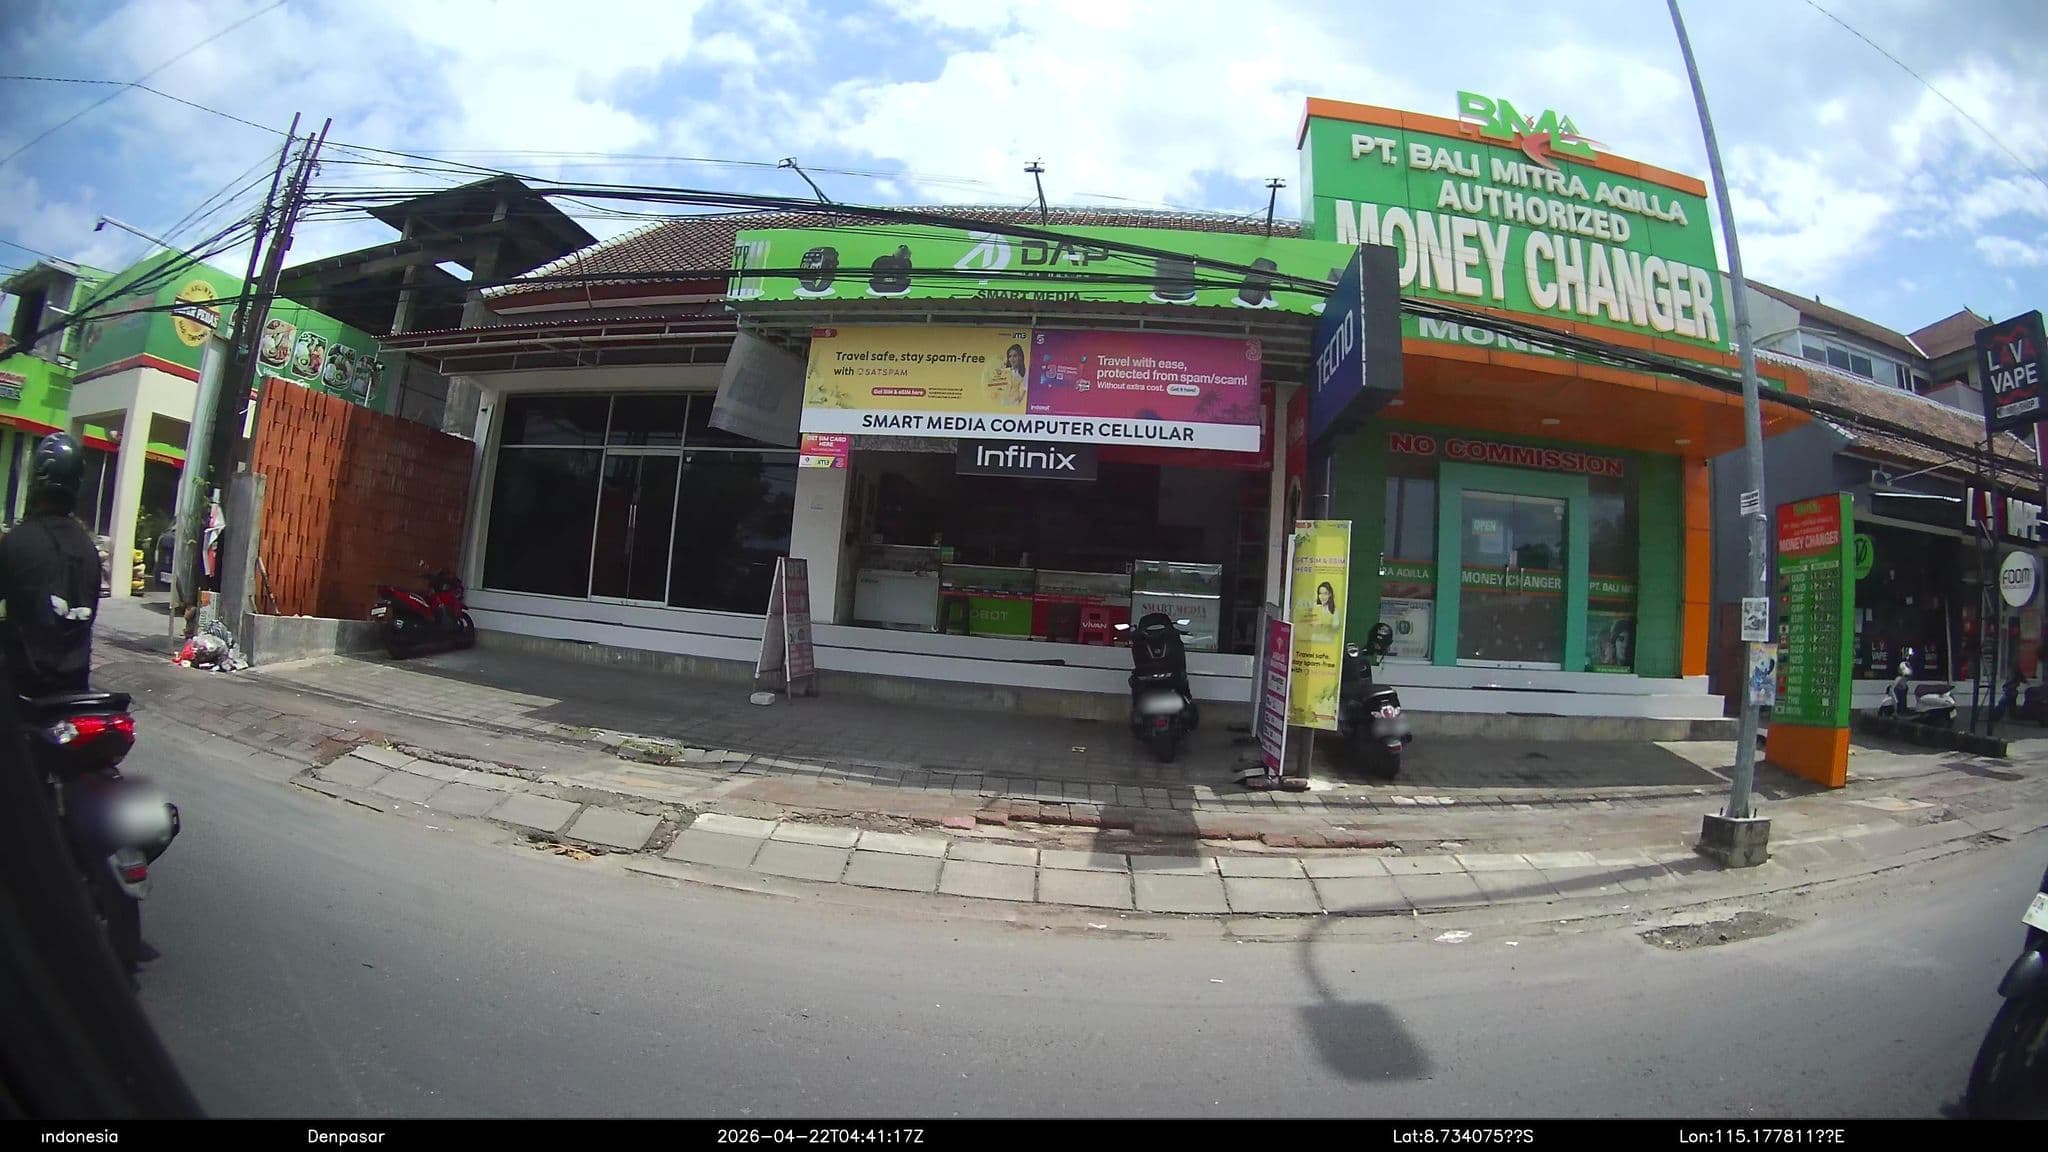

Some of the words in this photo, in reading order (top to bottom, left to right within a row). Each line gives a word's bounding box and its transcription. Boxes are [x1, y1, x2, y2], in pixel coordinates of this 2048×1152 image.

[1351, 134, 1398, 165] PT.
[1408, 142, 1481, 178] BALI
[1491, 157, 1590, 200] MITRA
[1437, 180, 1631, 243] AUTHORIZED
[1021, 240, 1109, 266] DAP
[1335, 199, 1511, 300] MONEY
[1524, 230, 1720, 343] CHANGER
[977, 290, 1026, 300] SMART
[1033, 291, 1081, 302] MEDIA
[836, 351, 869, 361] Travel
[871, 351, 898, 362] safe,
[901, 352, 923, 364] stay
[926, 352, 985, 364] spam-free
[1316, 309, 1354, 392] TECNO
[834, 366, 855, 376] with
[1097, 355, 1130, 367] Travel
[1133, 356, 1156, 368] with
[1158, 360, 1187, 371] ease,
[1096, 369, 1150, 380] protected
[1152, 370, 1178, 381] from
[1180, 373, 1248, 386] spam/scam!
[1097, 381, 1126, 390] Without
[1990, 363, 2039, 394] VAPE
[862, 414, 923, 430] SMART
[926, 416, 986, 432] MEDIA
[990, 418, 1094, 436] COMPUTER
[1098, 423, 1195, 442] CELLULAR
[976, 444, 1077, 471] Infinix
[1390, 432, 1436, 456] NO
[1445, 438, 1625, 477] COMMISSION
[1462, 570, 1504, 585] MONEY
[2002, 568, 2030, 585] FOOM
[960, 610, 1009, 621] OBOT
